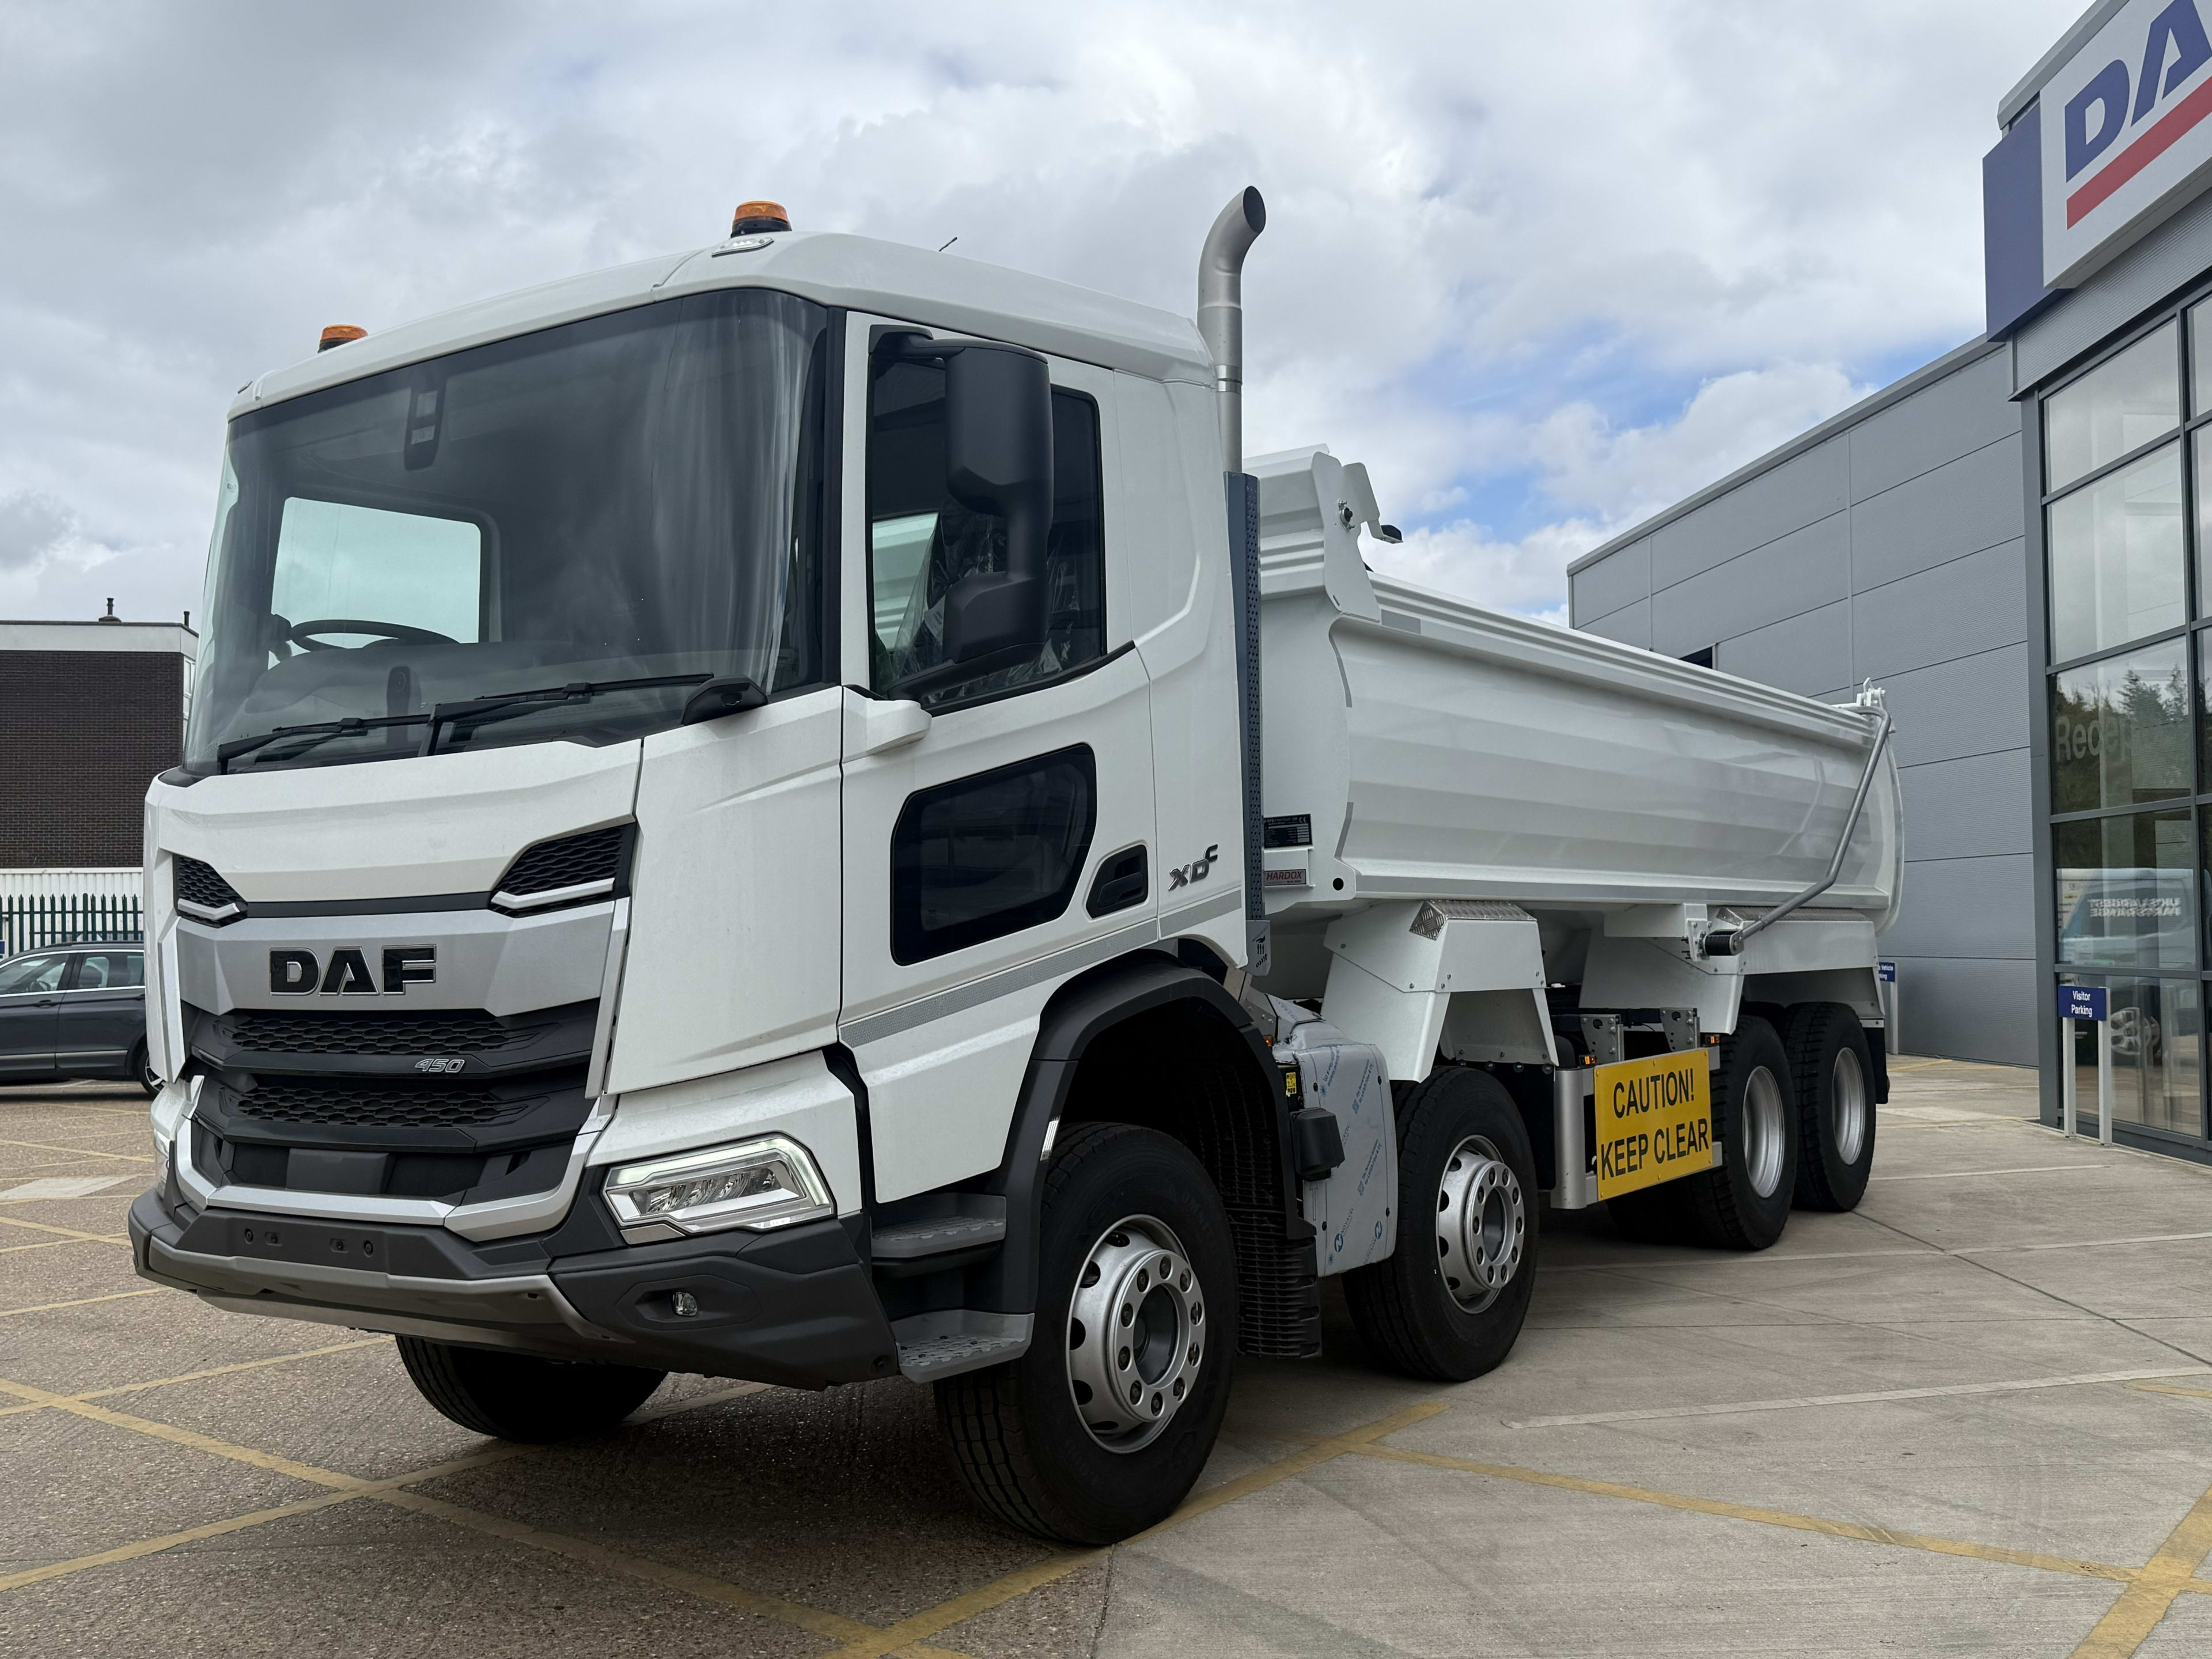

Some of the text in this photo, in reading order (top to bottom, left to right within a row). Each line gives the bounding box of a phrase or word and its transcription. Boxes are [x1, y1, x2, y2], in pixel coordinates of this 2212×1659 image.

[1267, 870, 1302, 881] HARDOX
[269, 944, 437, 997] DAF
[2073, 990, 2091, 1001] Visitor
[2071, 1004, 2092, 1018] Parking
[415, 1058, 465, 1073] 450
[1613, 1068, 1695, 1118] CAUTION!
[1601, 1118, 1709, 1180] KEEP CLEAR
